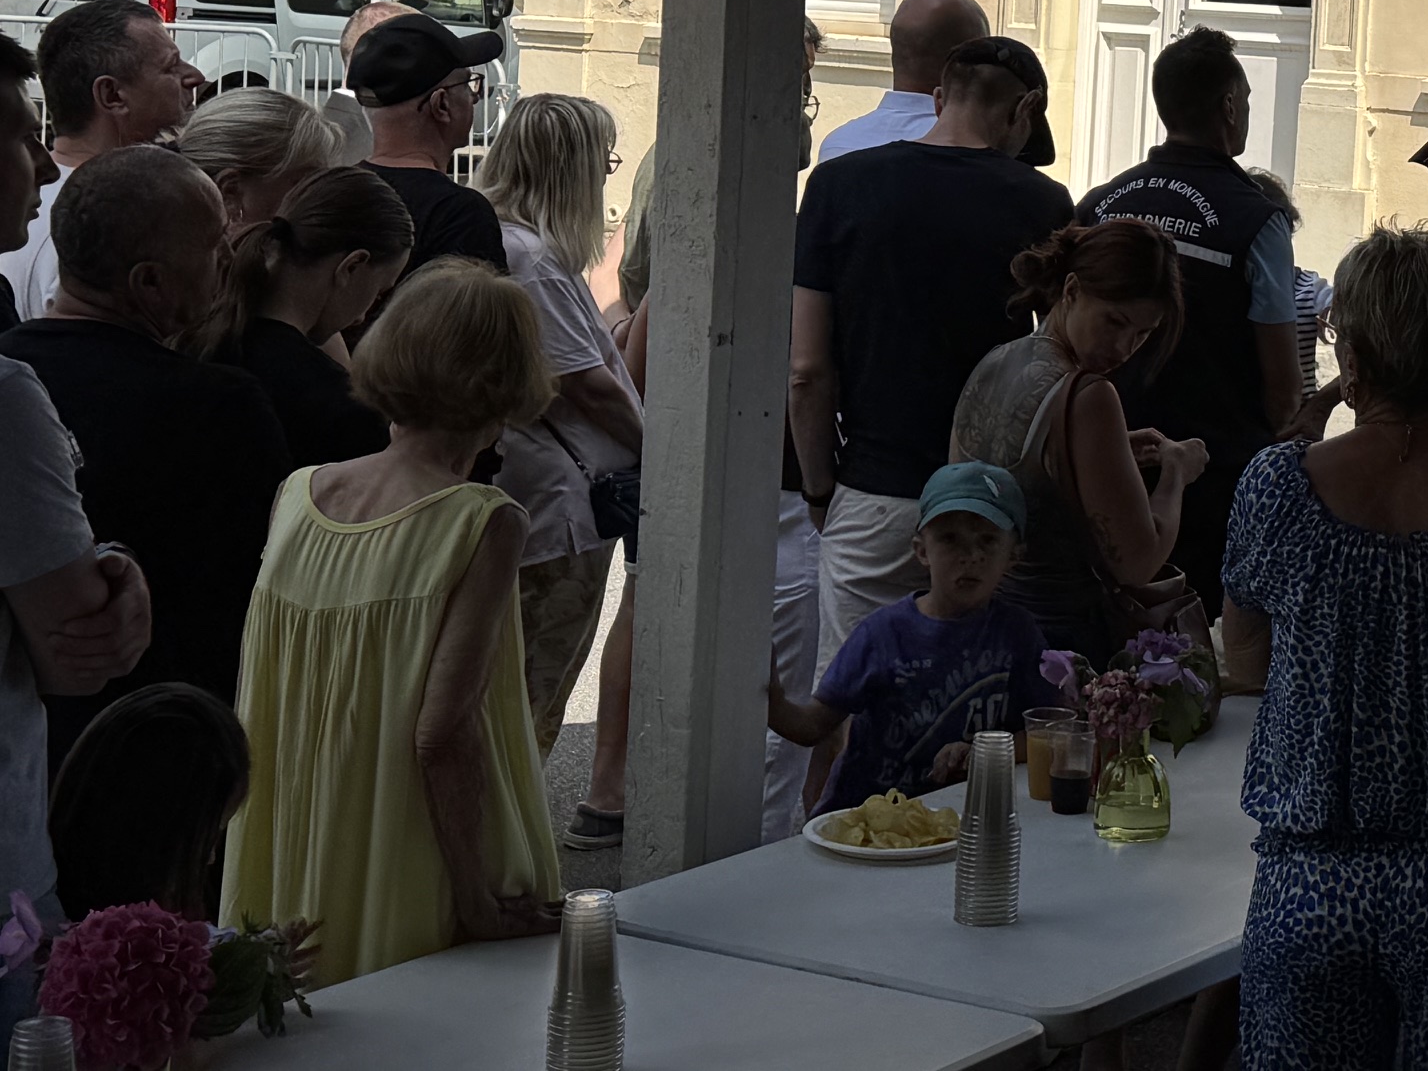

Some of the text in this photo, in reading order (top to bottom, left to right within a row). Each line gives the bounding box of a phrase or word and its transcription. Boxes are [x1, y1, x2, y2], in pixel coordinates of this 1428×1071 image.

[1094, 177, 1219, 228] SECOURS EN MONTAGNE
